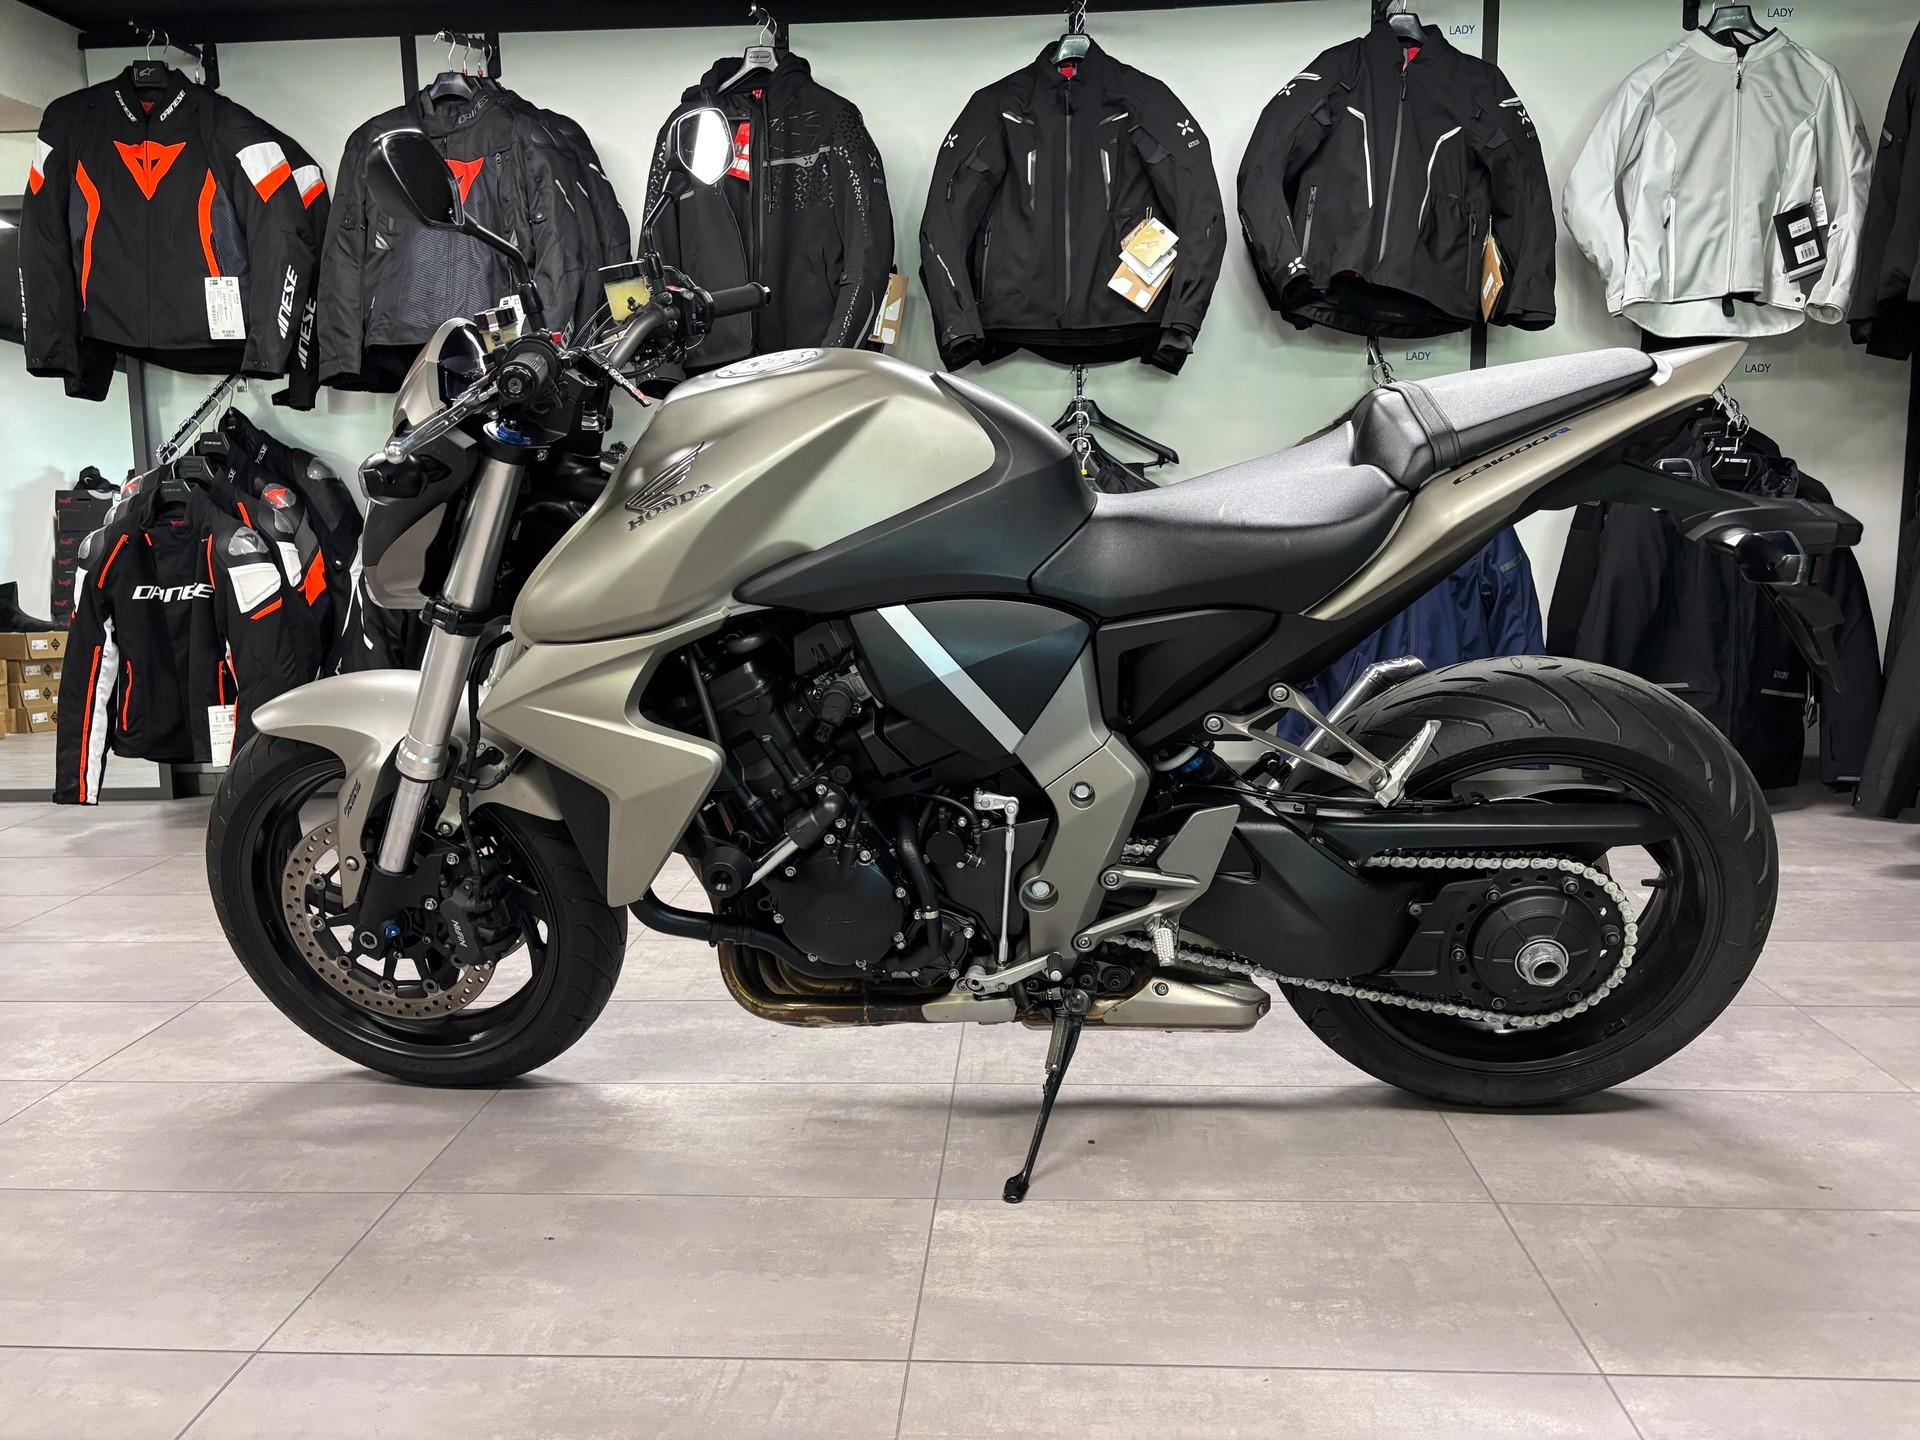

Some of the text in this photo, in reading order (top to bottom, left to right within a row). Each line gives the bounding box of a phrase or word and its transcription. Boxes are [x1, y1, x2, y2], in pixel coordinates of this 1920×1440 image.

[1766, 8, 1794, 18] LADY
[1449, 25, 1476, 35] LADY
[159, 89, 186, 122] DAINESE
[1405, 351, 1432, 361] LADY
[1744, 363, 1772, 373] LADY
[1452, 426, 1572, 486] CB1000R
[627, 483, 717, 532] HONDA
